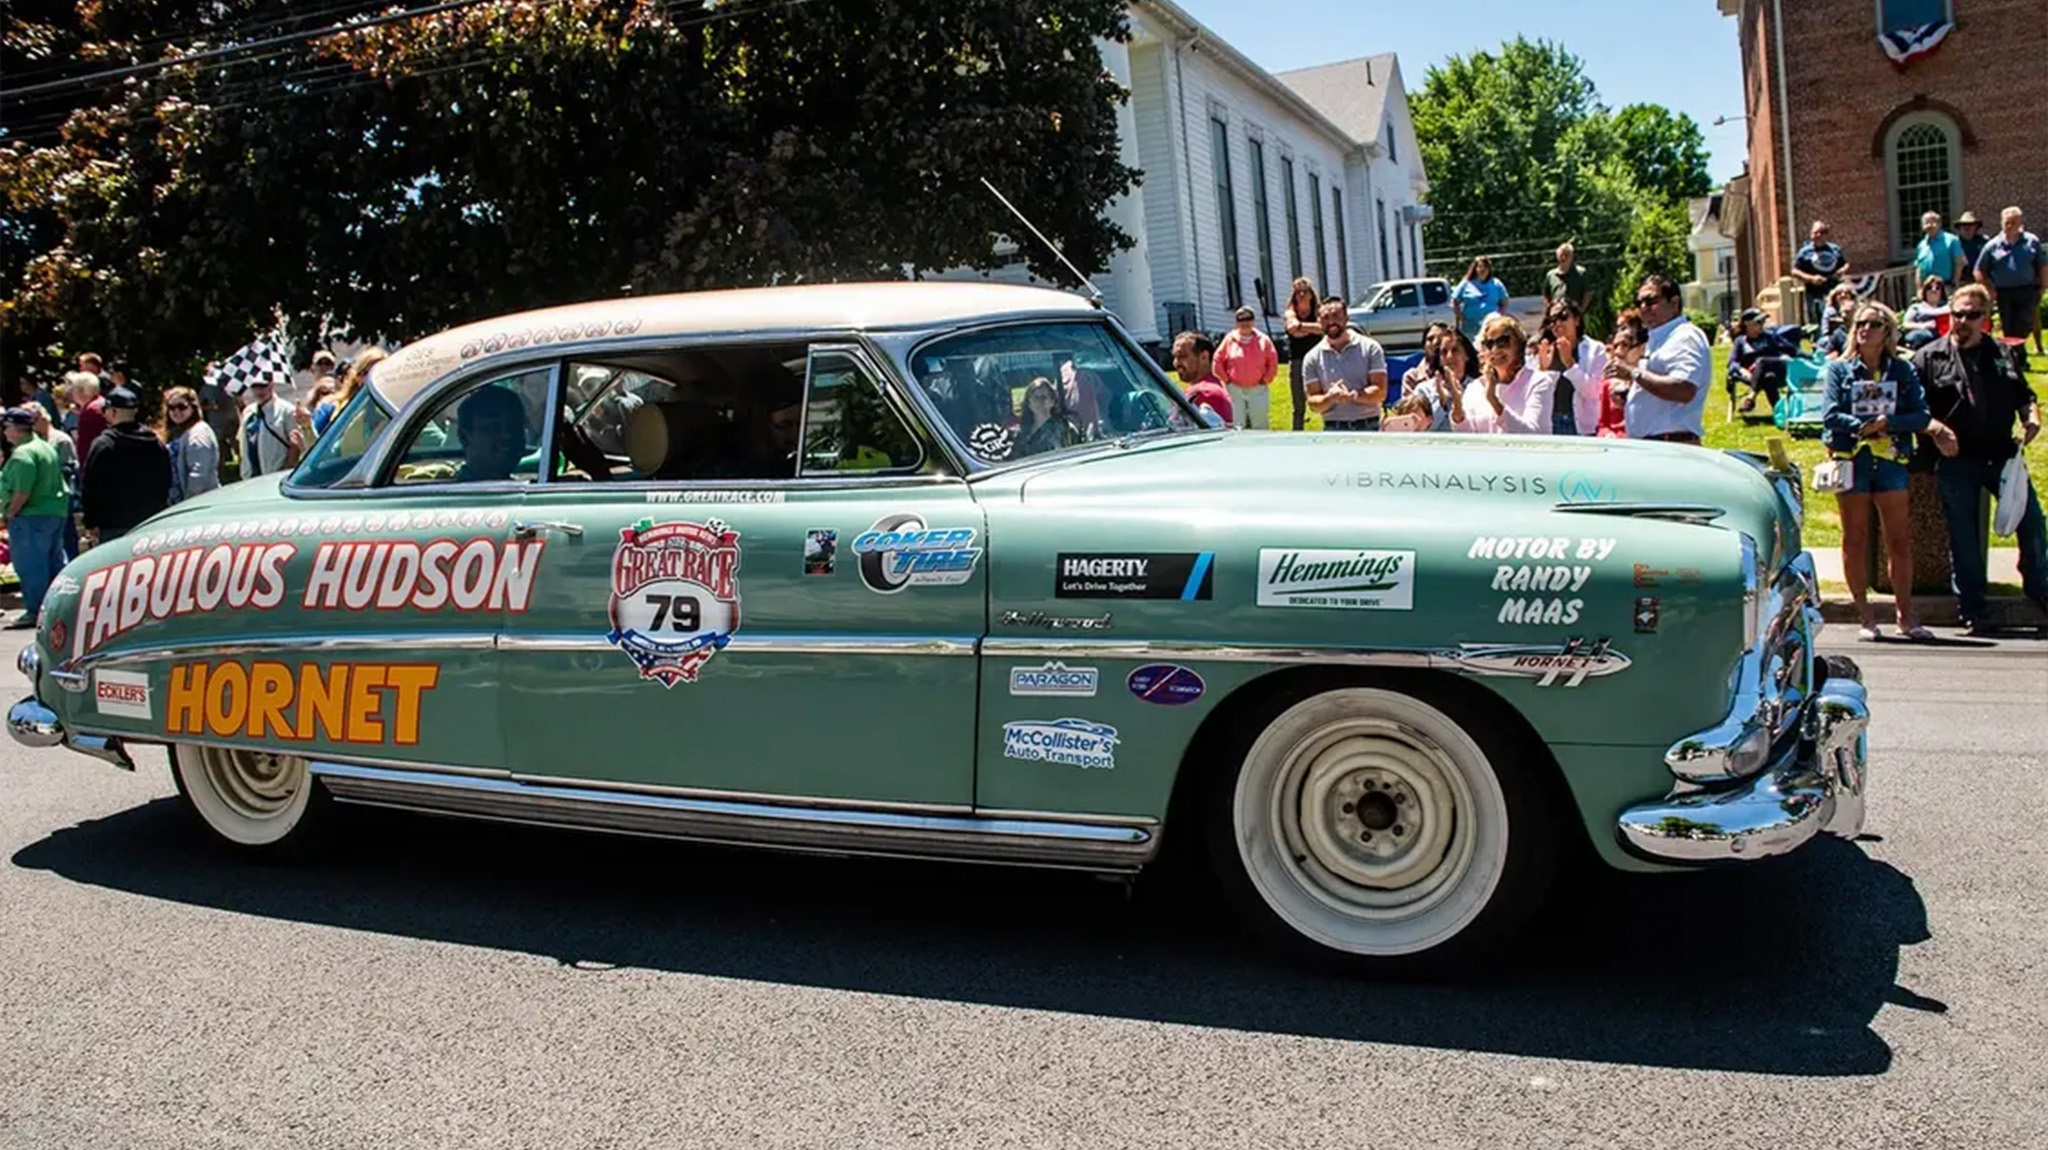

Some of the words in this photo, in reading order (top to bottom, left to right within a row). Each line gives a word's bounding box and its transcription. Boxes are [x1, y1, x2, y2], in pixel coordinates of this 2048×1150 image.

[1324, 471, 1547, 495] VIBRANALYSIS
[645, 491, 785, 504] WWW.GREATRACE.COM
[855, 529, 973, 552] COKER
[1467, 536, 1571, 560] MOTOR
[1575, 537, 1617, 561] BY
[615, 544, 682, 596] GREAT
[683, 547, 737, 599] RACE
[892, 550, 976, 574] TIRE
[1062, 558, 1148, 577] HAGERTY
[1267, 551, 1404, 585] Hemmings
[1062, 581, 1084, 591] Let's
[1084, 581, 1107, 591] Drive
[1109, 581, 1147, 593] Together
[1490, 564, 1592, 592] RANDY
[73, 541, 298, 664] FABULOUS
[300, 536, 548, 614] HUDSON
[1497, 597, 1584, 625] MAAS
[645, 594, 701, 633] 79
[1514, 656, 1591, 669] HORNET
[97, 681, 147, 703] ECKLER'S
[1016, 673, 1093, 687] PARAGON
[166, 660, 440, 746] HORNET
[1007, 727, 1112, 754] McCollister's
[1007, 744, 1040, 759] Auto
[1044, 748, 1113, 767] Transport
